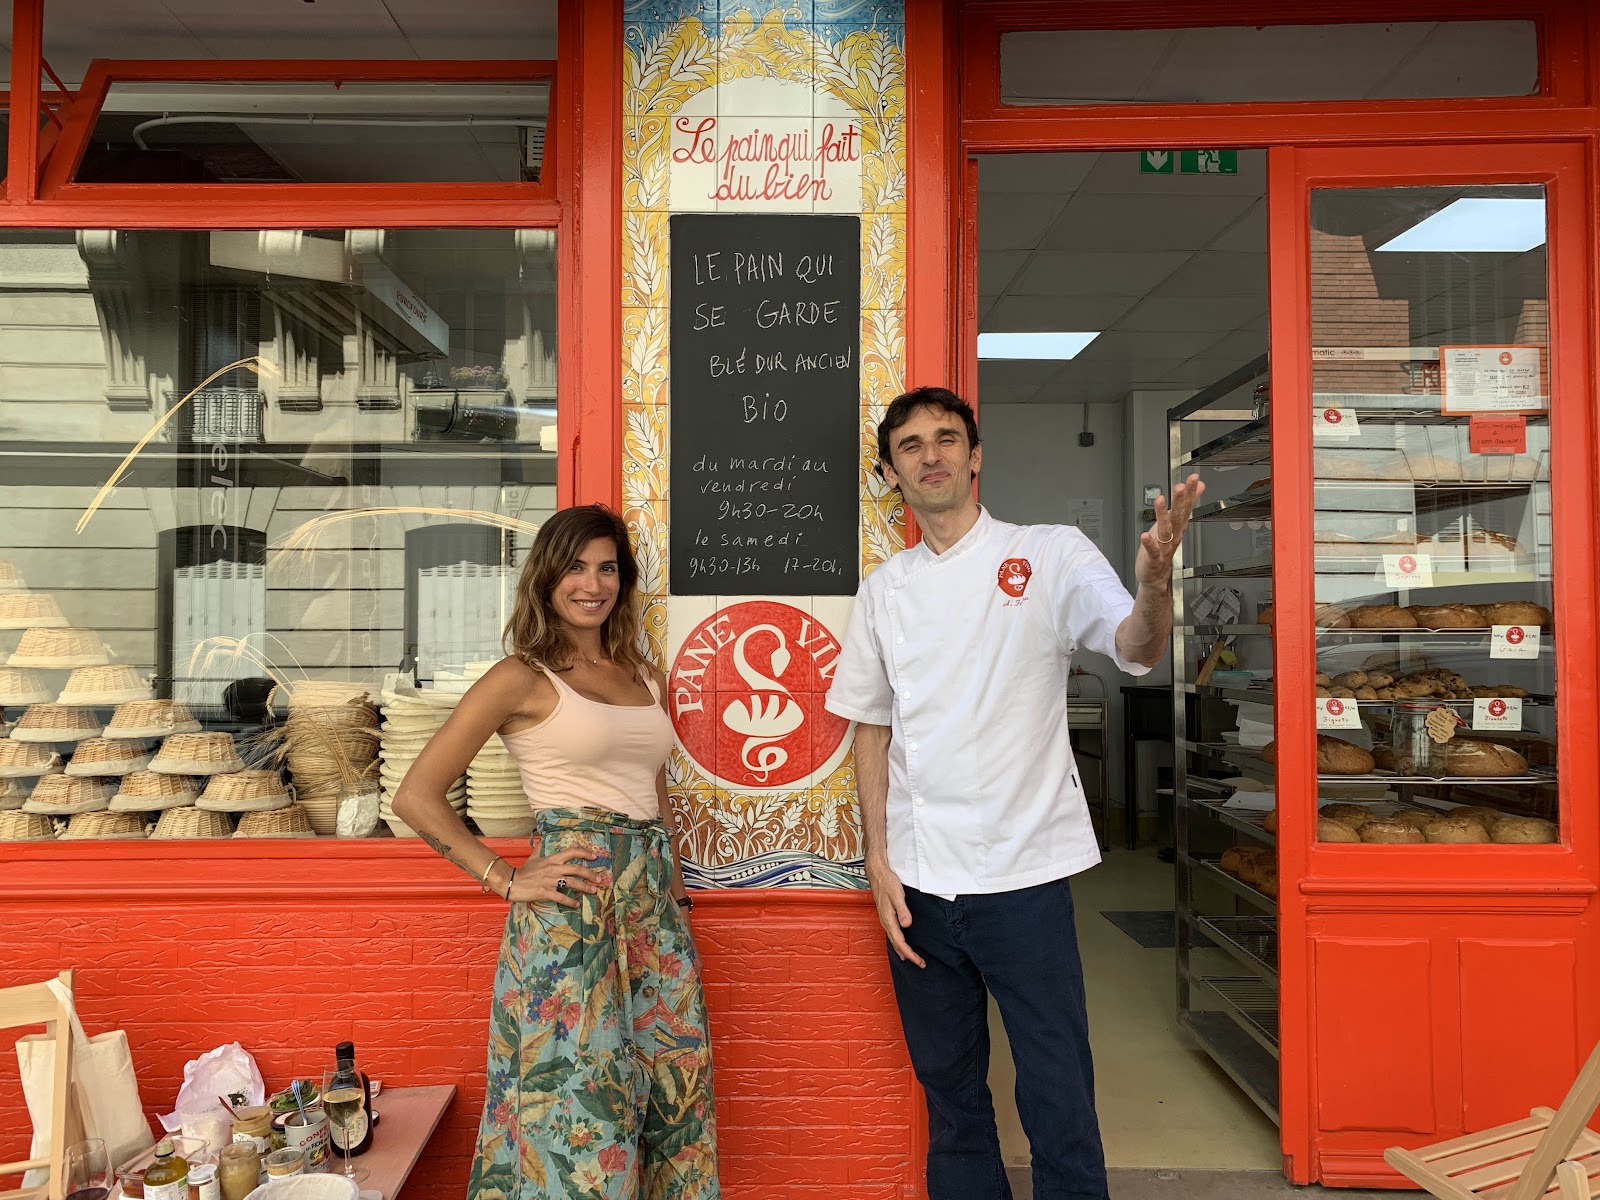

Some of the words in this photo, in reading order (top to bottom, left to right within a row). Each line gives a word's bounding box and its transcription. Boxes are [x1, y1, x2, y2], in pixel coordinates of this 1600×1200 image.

[672, 117, 717, 164] Le
[815, 123, 860, 178] fait
[693, 252, 721, 285] LE
[734, 252, 783, 285] PAIN
[796, 254, 833, 283] QUI
[693, 303, 725, 330] SE
[756, 299, 840, 328] GARDE
[710, 347, 746, 377] BLÉ
[756, 352, 787, 374] DUR
[795, 345, 851, 373] ANCIEN
[693, 455, 718, 472] du
[730, 455, 795, 471] mardi
[802, 457, 828, 473] au
[700, 476, 796, 493] vendredi
[695, 529, 709, 546] le
[721, 532, 802, 546] samedi
[675, 614, 737, 721] PANE
[796, 616, 843, 680] VIV
